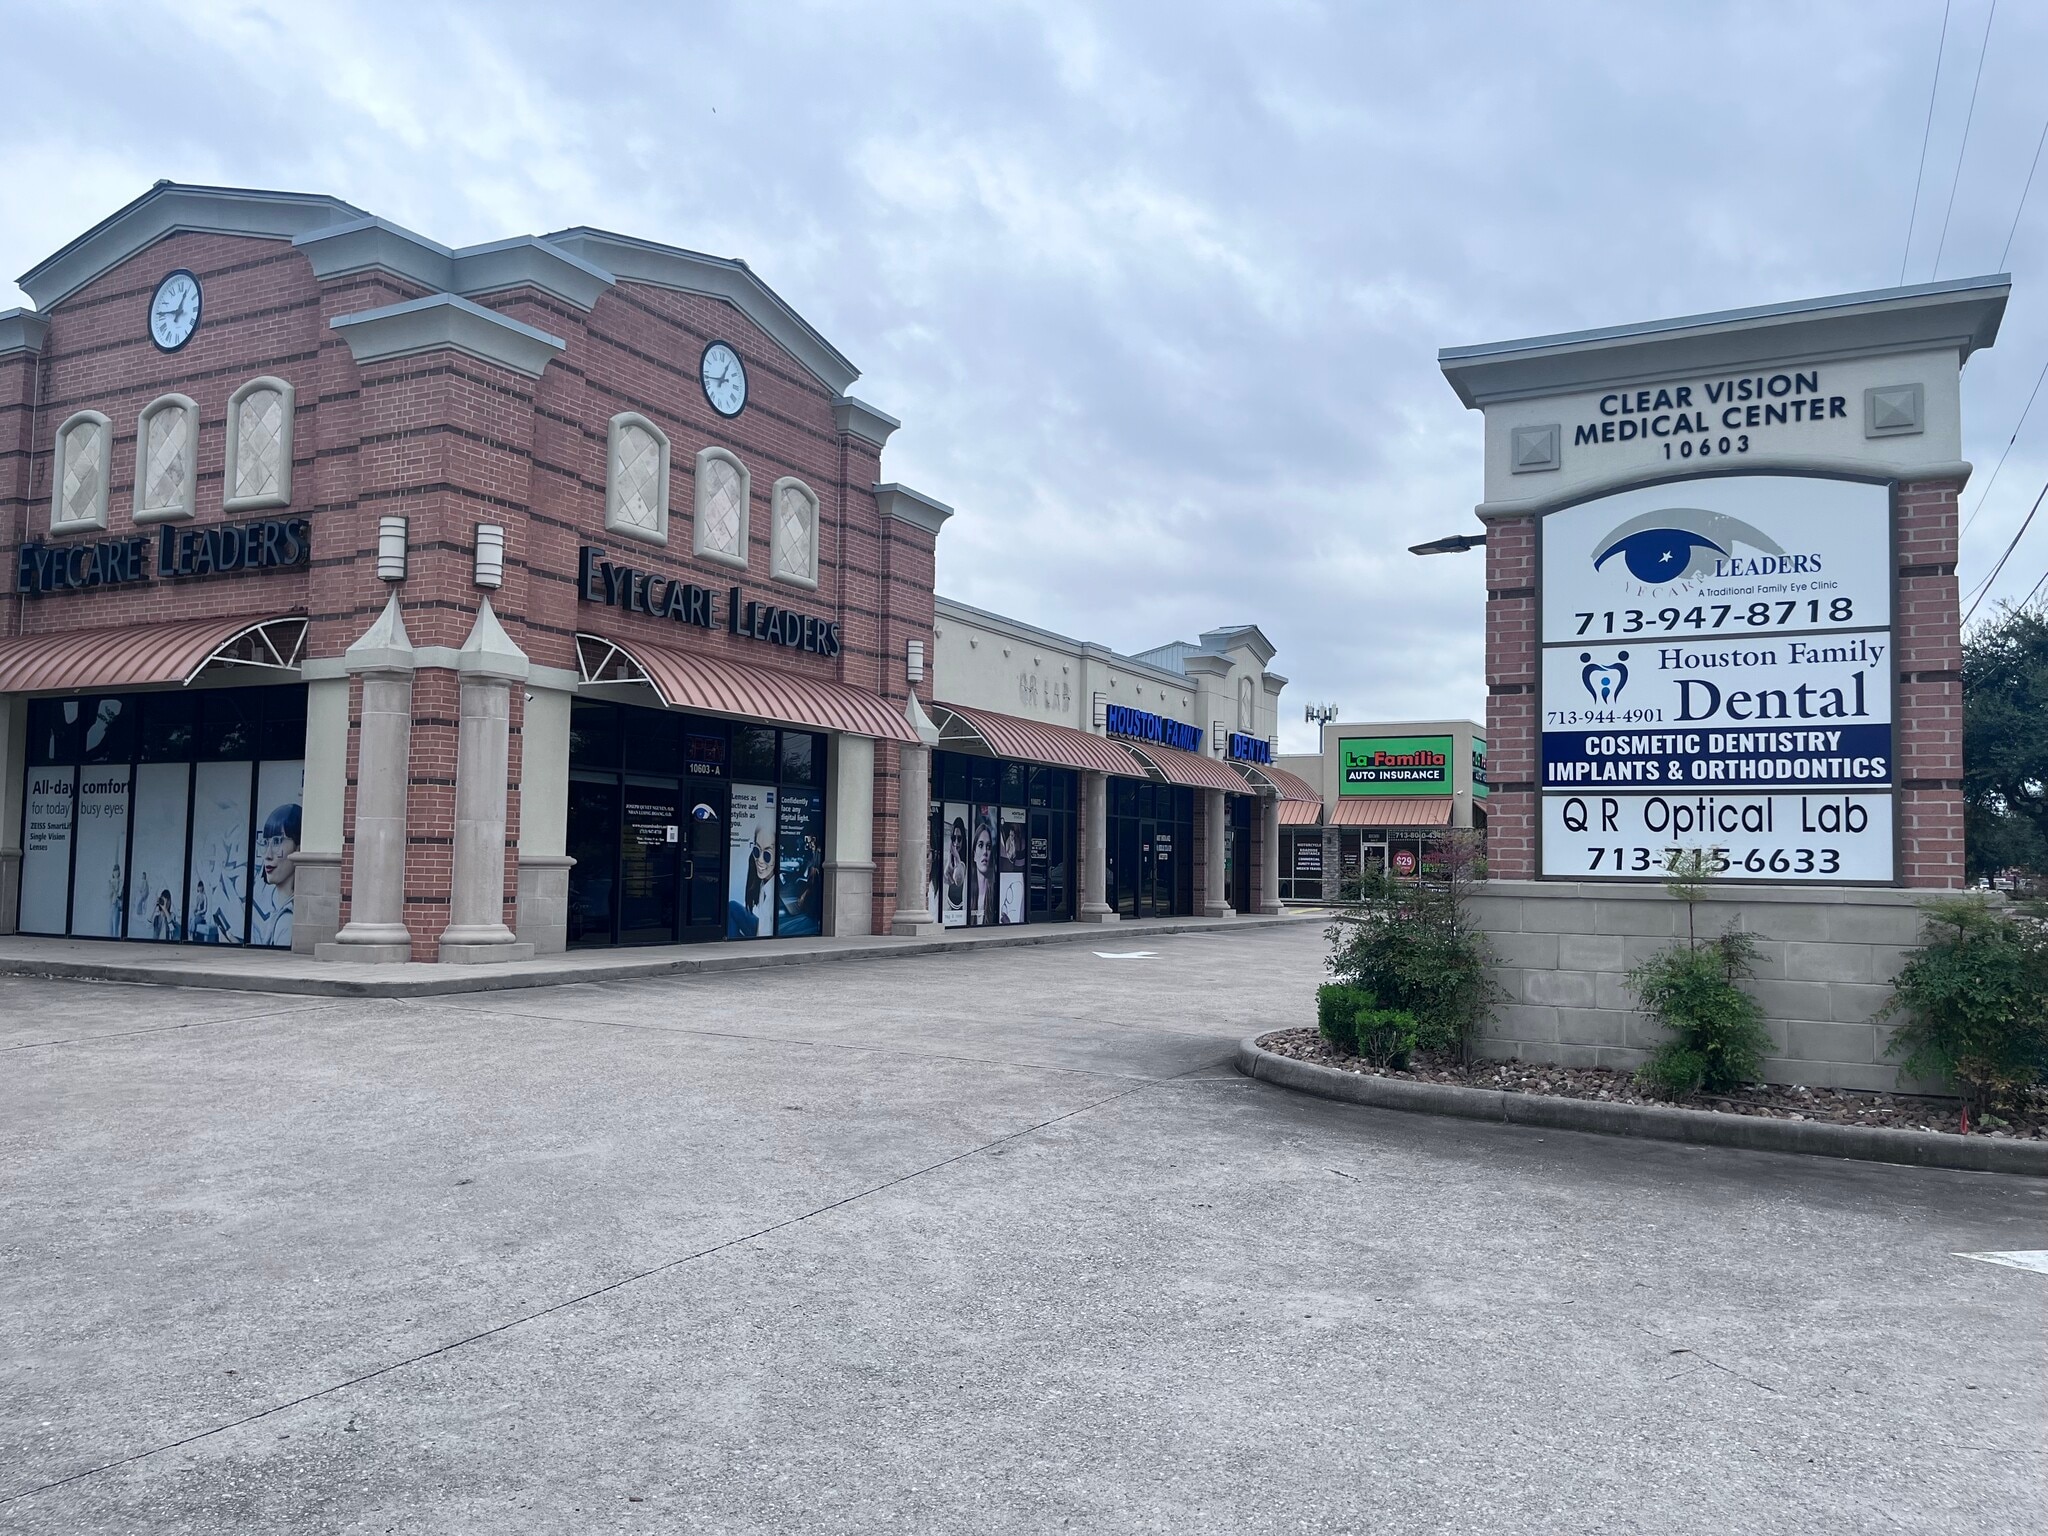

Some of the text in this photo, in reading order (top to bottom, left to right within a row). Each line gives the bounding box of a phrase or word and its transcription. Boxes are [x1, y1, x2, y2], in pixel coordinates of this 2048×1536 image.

[1599, 371, 1819, 417] CLEAR VISION
[1574, 396, 1848, 446] MEDICAL CENTER
[1663, 435, 1750, 460] 10603
[17, 518, 304, 593] EYECARE LEADERS
[1715, 553, 1822, 578] LEADERS
[1698, 580, 1838, 597] A Traditional Family Eye Clinic
[578, 546, 841, 657] EYECARE LEADERS
[1575, 597, 1854, 636] 713-947-8718
[1658, 639, 1885, 670] Houston Family
[1673, 671, 1870, 723] Dental
[1108, 704, 1203, 752] HOUSTON FAMILY
[1547, 708, 1663, 726] 713-944-4901
[1585, 731, 1842, 756] COSMETIC DENTISTRY
[1346, 750, 1446, 768] La Familia
[1548, 757, 1887, 782] IMPLANTS & ORTHODONTICS
[1348, 770, 1440, 780] AUTO INSURANCE
[32, 779, 74, 798] All-day
[32, 801, 44, 815] for
[81, 801, 101, 818] busy
[104, 804, 124, 818] eyes
[1644, 796, 1773, 840] Optical
[1802, 796, 1868, 834] Lab
[29, 843, 48, 851] Lenses
[30, 832, 66, 841] Single Vision
[1396, 856, 1412, 866] $29
[1588, 847, 1841, 874] 713-715-6633
